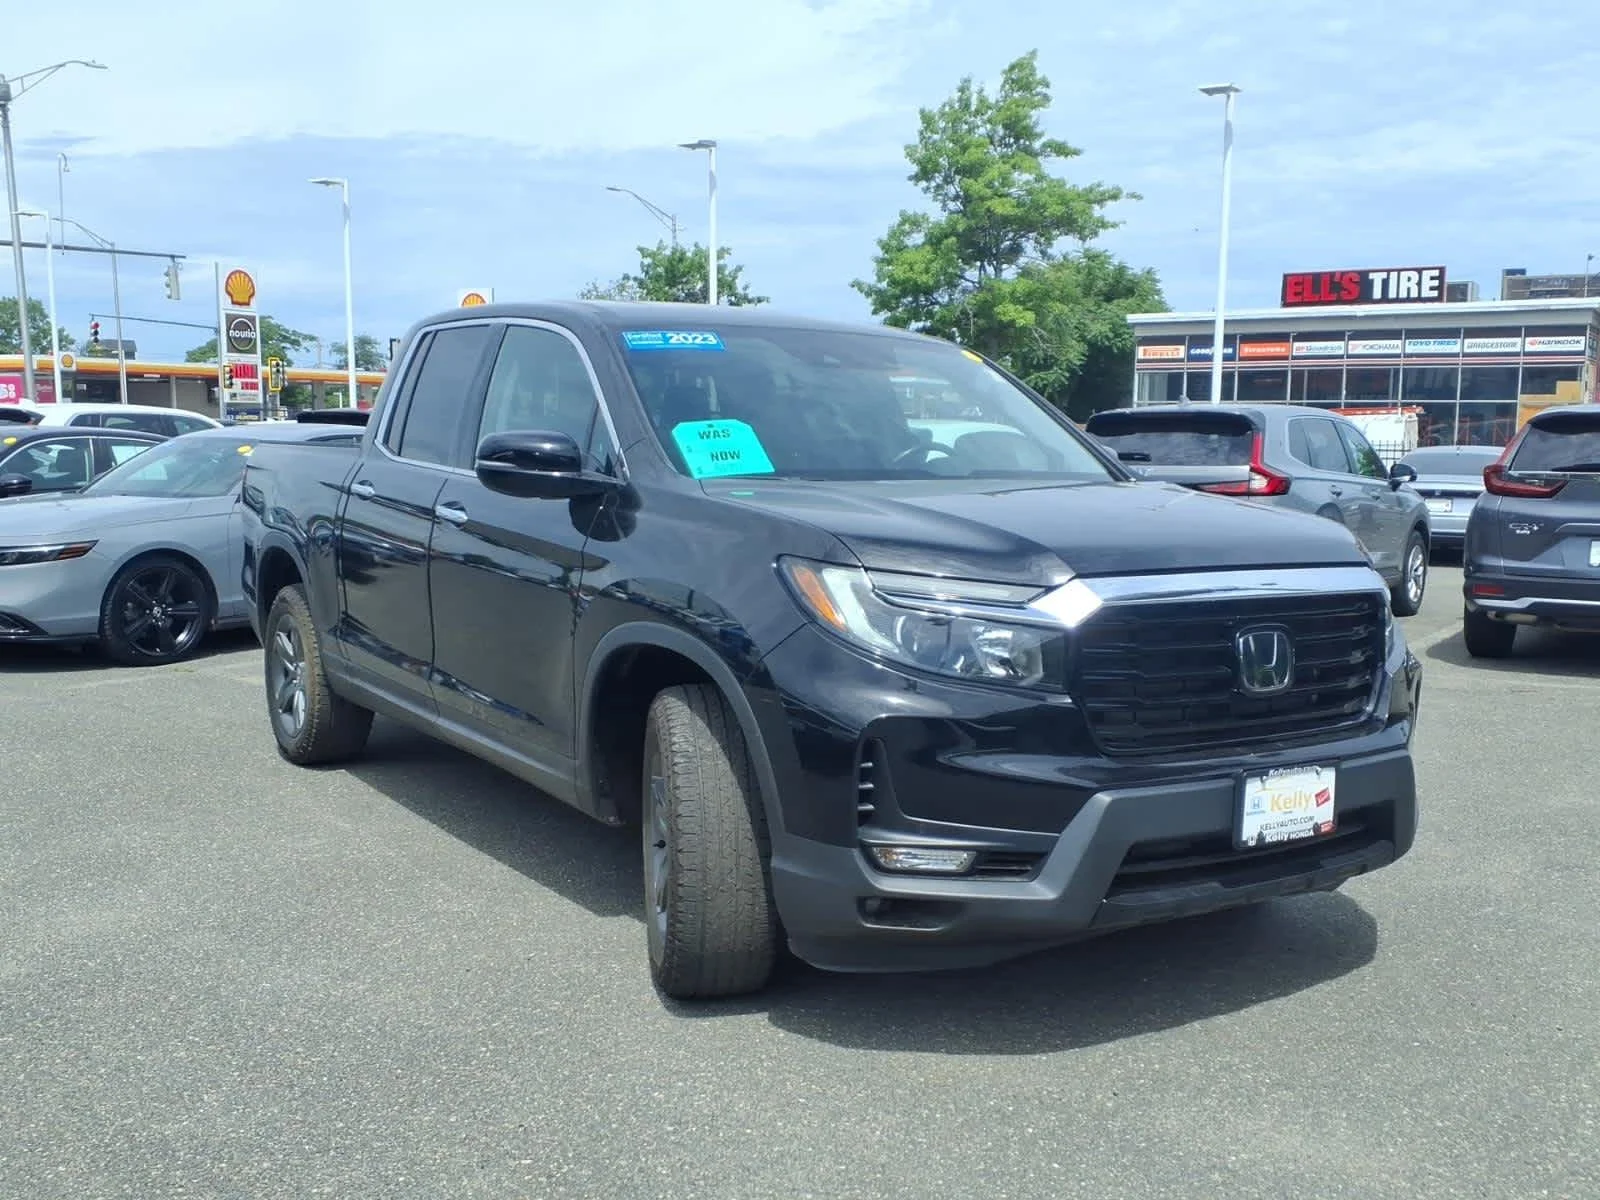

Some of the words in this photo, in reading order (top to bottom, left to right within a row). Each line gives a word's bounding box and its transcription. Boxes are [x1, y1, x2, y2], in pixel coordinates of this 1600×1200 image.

[1286, 272, 1360, 303] ELL'S
[1368, 269, 1440, 299] TIRE
[667, 333, 717, 345] 2023
[1466, 340, 1518, 348] BRIDGESTONE
[1190, 346, 1233, 354] GOODAR
[1362, 342, 1400, 350] YOKOHAMA
[697, 429, 731, 441] WAS
[709, 450, 741, 462] NOW
[1271, 790, 1312, 812] Kelly
[1259, 815, 1315, 831] KELLYAUTO.COM
[1265, 831, 1290, 843] Kelly
[1290, 829, 1314, 839] HONDA
